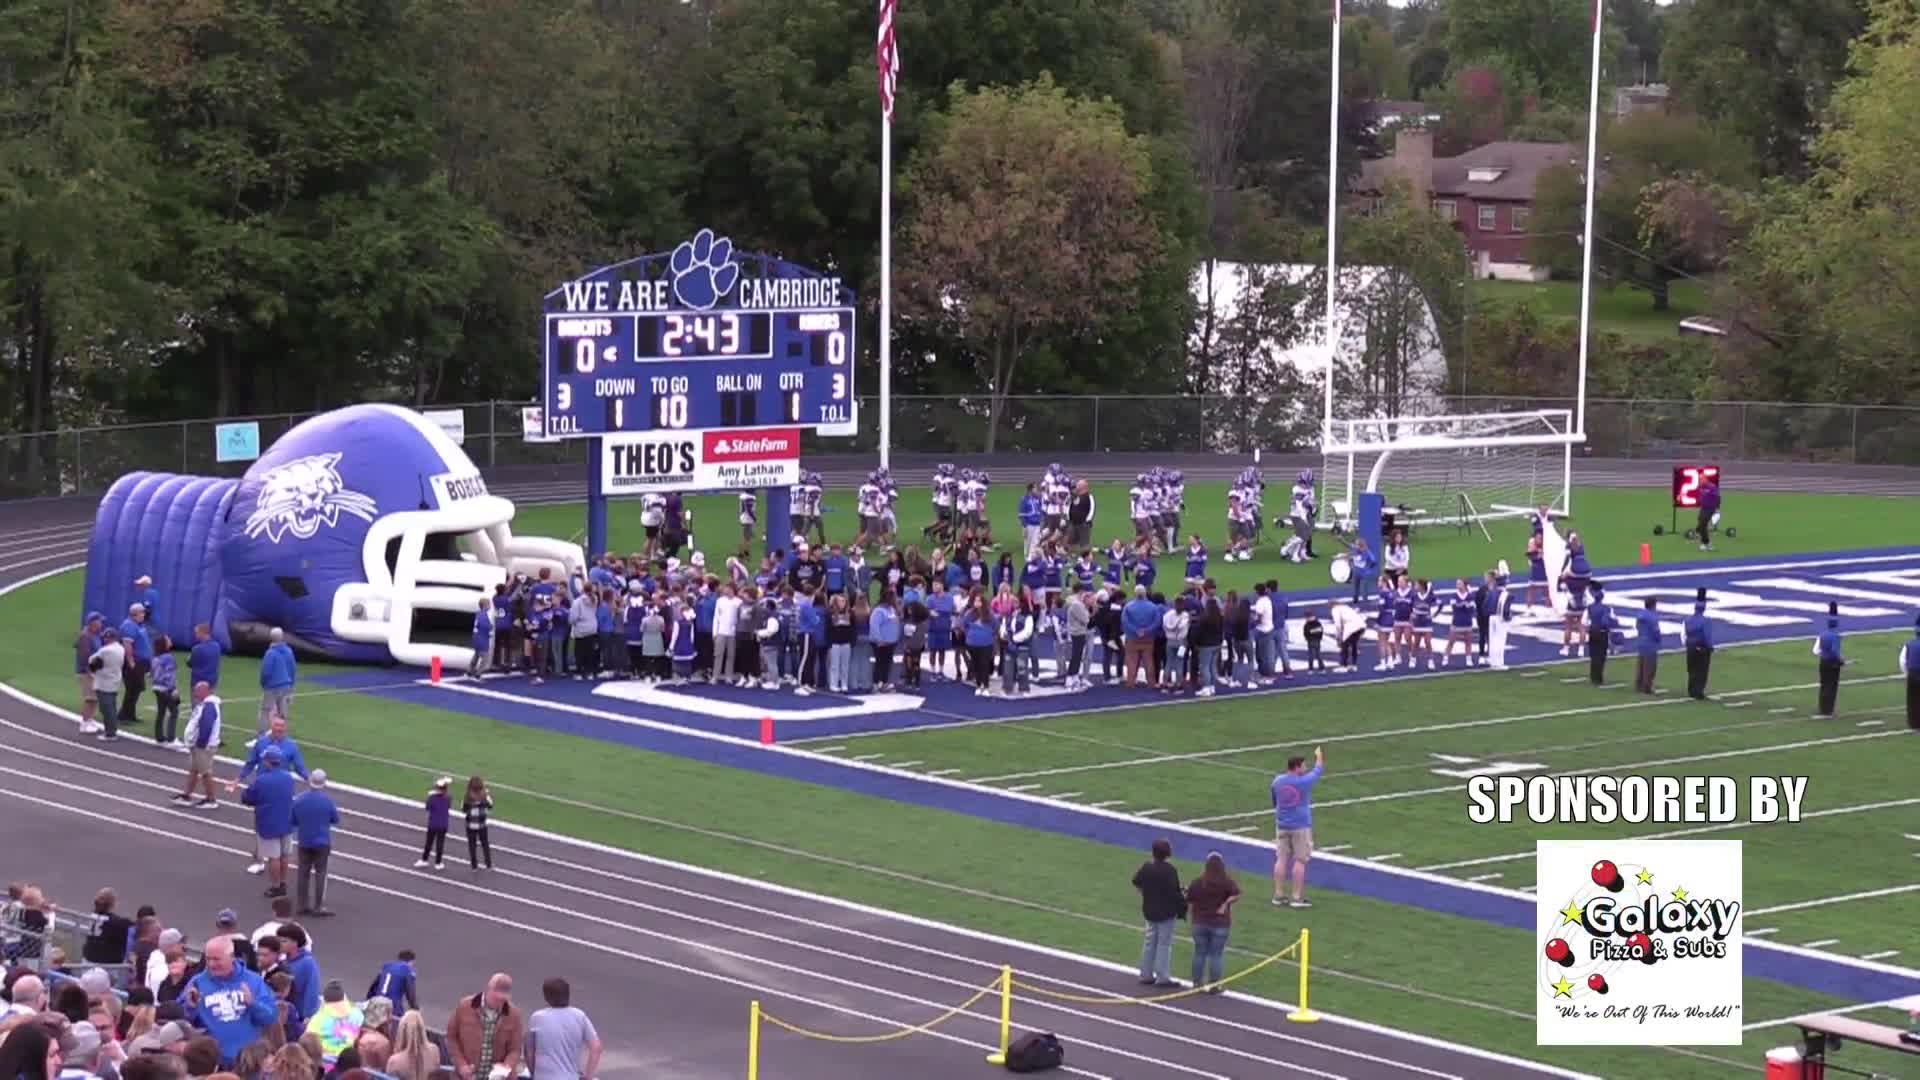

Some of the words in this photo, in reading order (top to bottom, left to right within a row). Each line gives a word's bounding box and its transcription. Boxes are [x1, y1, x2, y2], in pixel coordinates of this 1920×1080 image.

[563, 281, 609, 311] WE
[617, 280, 669, 311] ARE
[740, 278, 841, 308] CAMBRIDGE
[663, 314, 739, 355] 2:43
[828, 331, 845, 365] 0
[577, 338, 595, 372] 0
[595, 378, 635, 397] DOWN
[651, 376, 667, 394] TO
[671, 376, 689, 394] GO
[716, 374, 743, 392] BALL
[746, 373, 762, 391] ON
[779, 372, 804, 390] QTR
[832, 373, 845, 399] 3
[558, 383, 571, 410] 3
[792, 391, 800, 421] 1
[551, 416, 583, 433] T.O.L.
[615, 398, 623, 429] 1
[660, 394, 688, 428] 10
[820, 405, 848, 422] T.O.L.
[610, 441, 695, 476] THEO'S
[717, 464, 741, 480] Amy
[744, 463, 784, 477] Latham
